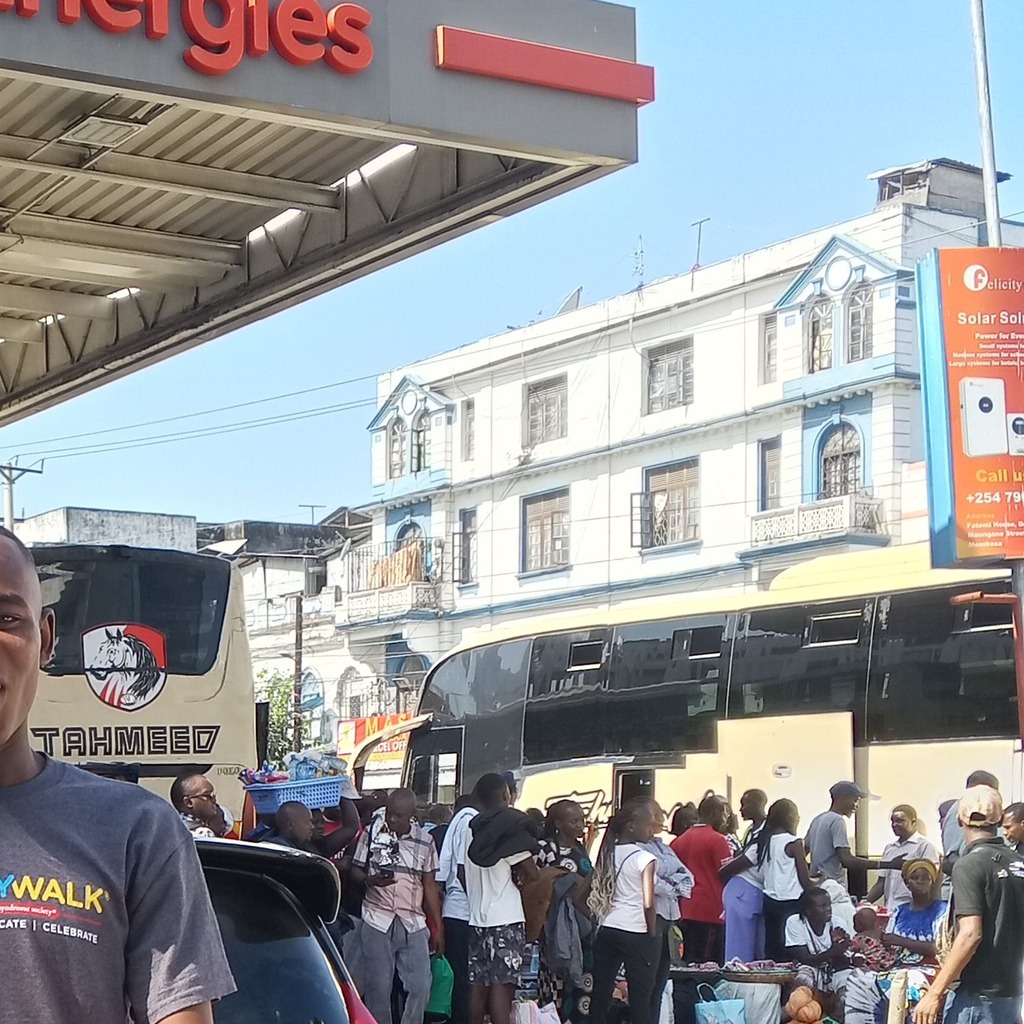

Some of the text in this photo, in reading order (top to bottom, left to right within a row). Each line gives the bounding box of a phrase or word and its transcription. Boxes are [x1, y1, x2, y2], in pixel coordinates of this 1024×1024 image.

[957, 311, 1024, 325] Solar Sol
[976, 469, 1008, 482] Call
[966, 492, 1001, 504] +254
[30, 725, 221, 757] TAHMEED
[42, 922, 98, 944] CELEBRATE
